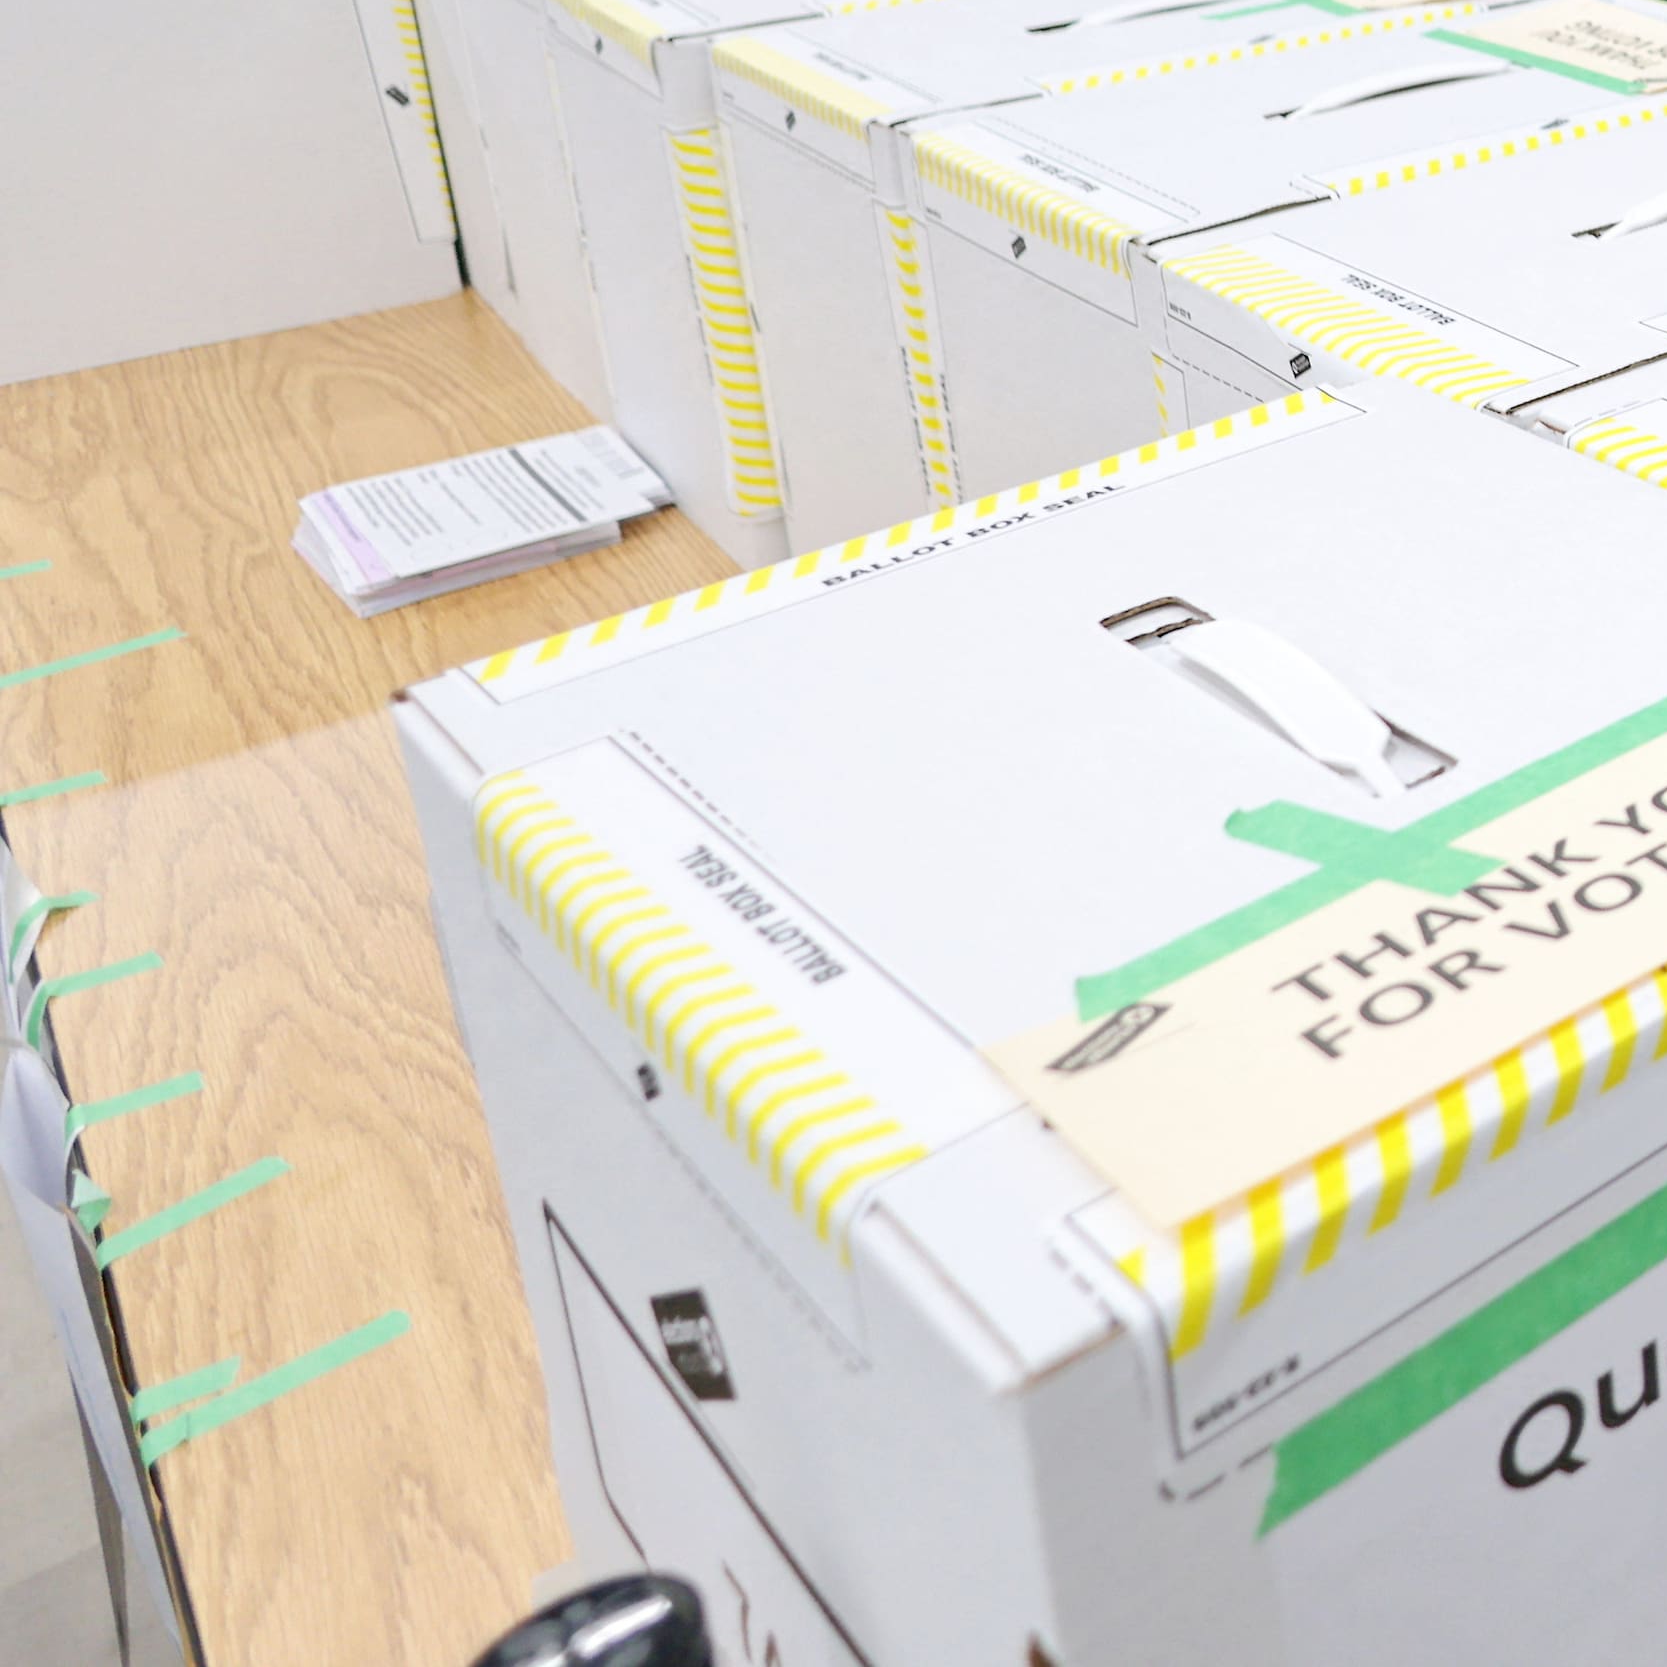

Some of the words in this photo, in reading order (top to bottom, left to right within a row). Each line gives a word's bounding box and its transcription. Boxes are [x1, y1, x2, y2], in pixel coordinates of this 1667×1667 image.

[822, 538, 954, 587] BALLOT
[966, 512, 1037, 539] BOX
[1043, 484, 1126, 513] SEAL
[678, 844, 738, 888] SEAL
[718, 883, 777, 922] BOX
[756, 918, 848, 986] BALLOT
[1271, 838, 1599, 1004] THANK
[1299, 948, 1507, 1061] FOR
